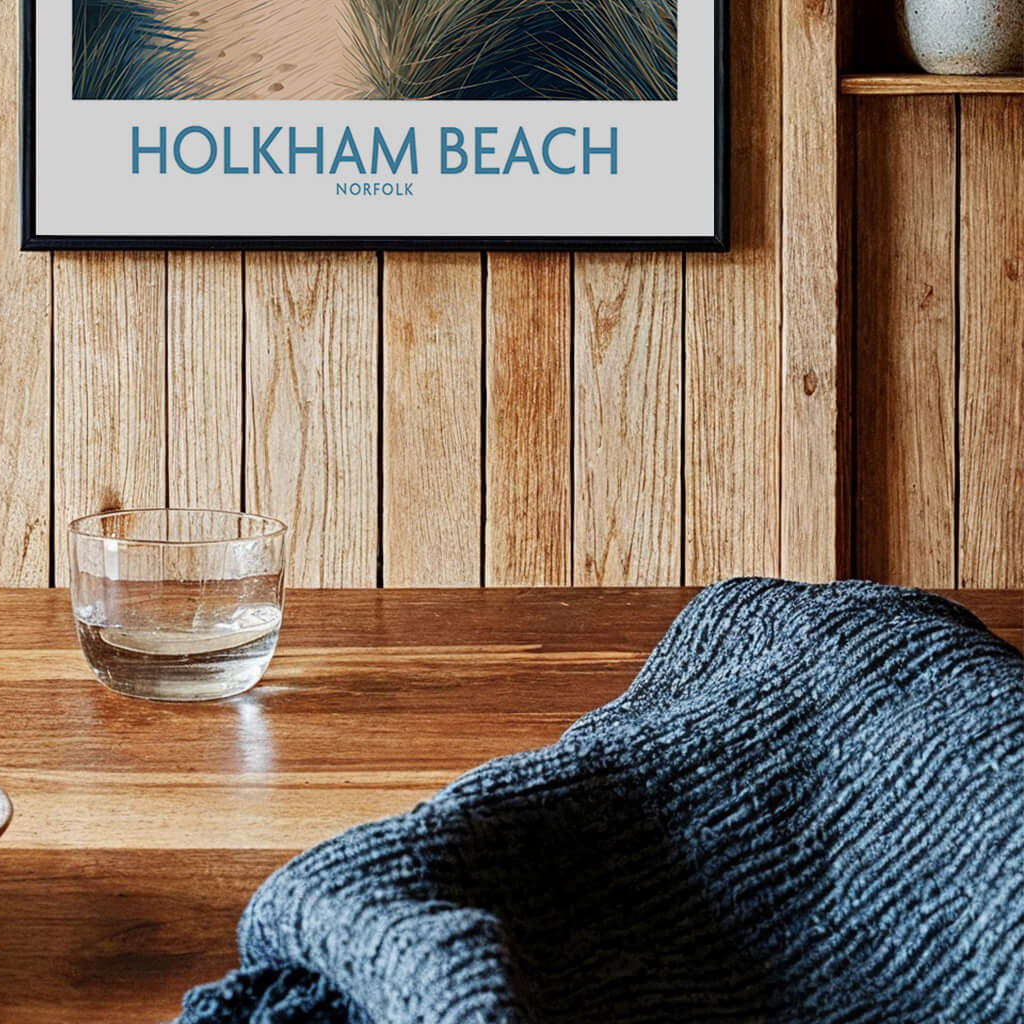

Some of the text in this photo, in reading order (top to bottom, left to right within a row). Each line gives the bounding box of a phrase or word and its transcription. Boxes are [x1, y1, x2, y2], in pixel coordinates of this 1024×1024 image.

[131, 125, 618, 175] HOLKHAM BEACH
[335, 182, 414, 196] NORFOLK
